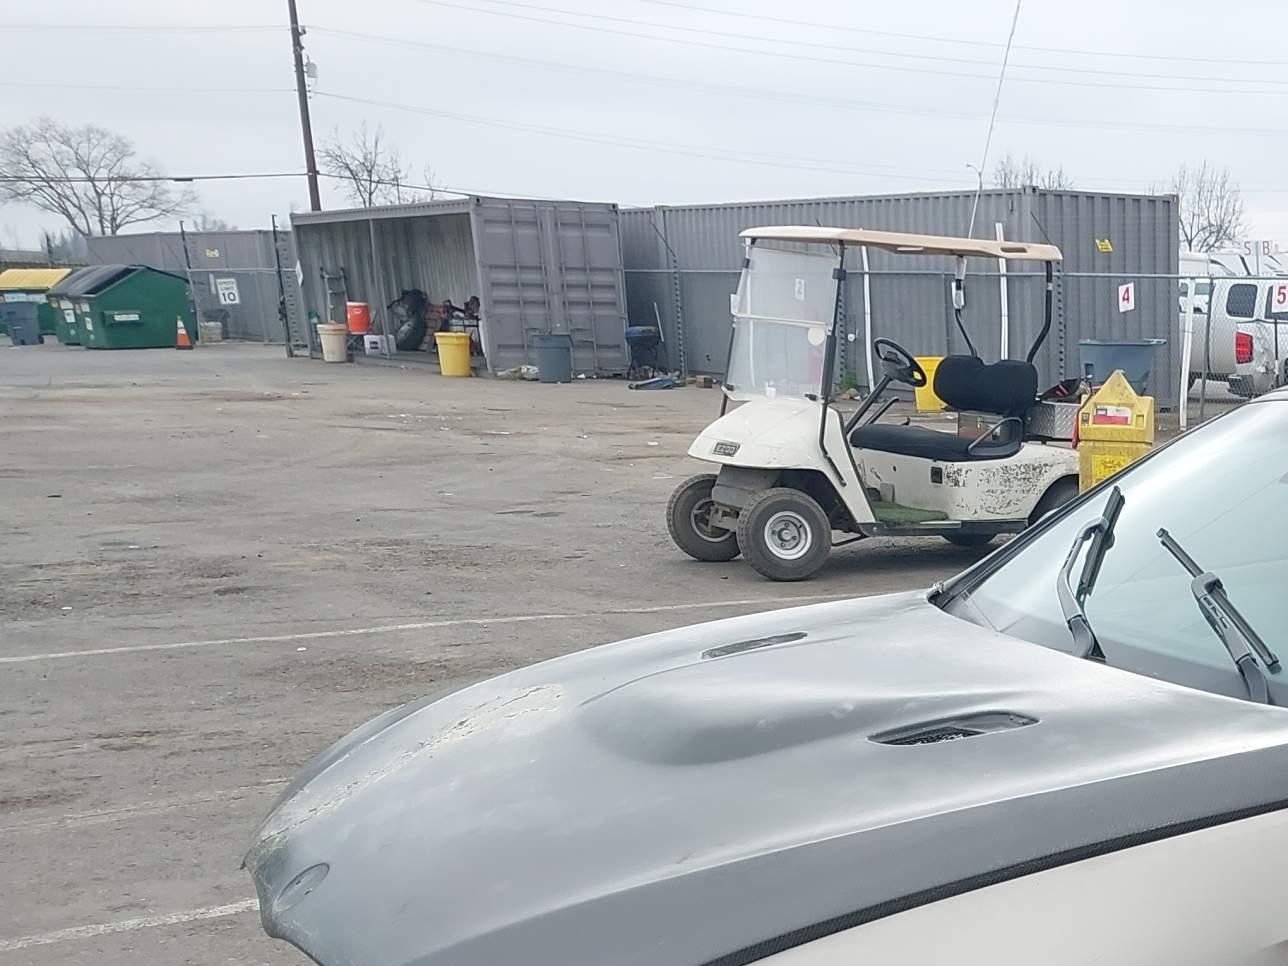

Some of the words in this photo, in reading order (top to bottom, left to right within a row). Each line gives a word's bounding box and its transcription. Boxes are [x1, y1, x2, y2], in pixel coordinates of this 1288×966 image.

[1263, 242, 1270, 255] B
[222, 292, 236, 302] 10
[1122, 287, 1130, 304] 4
[1277, 286, 1287, 305] 5
